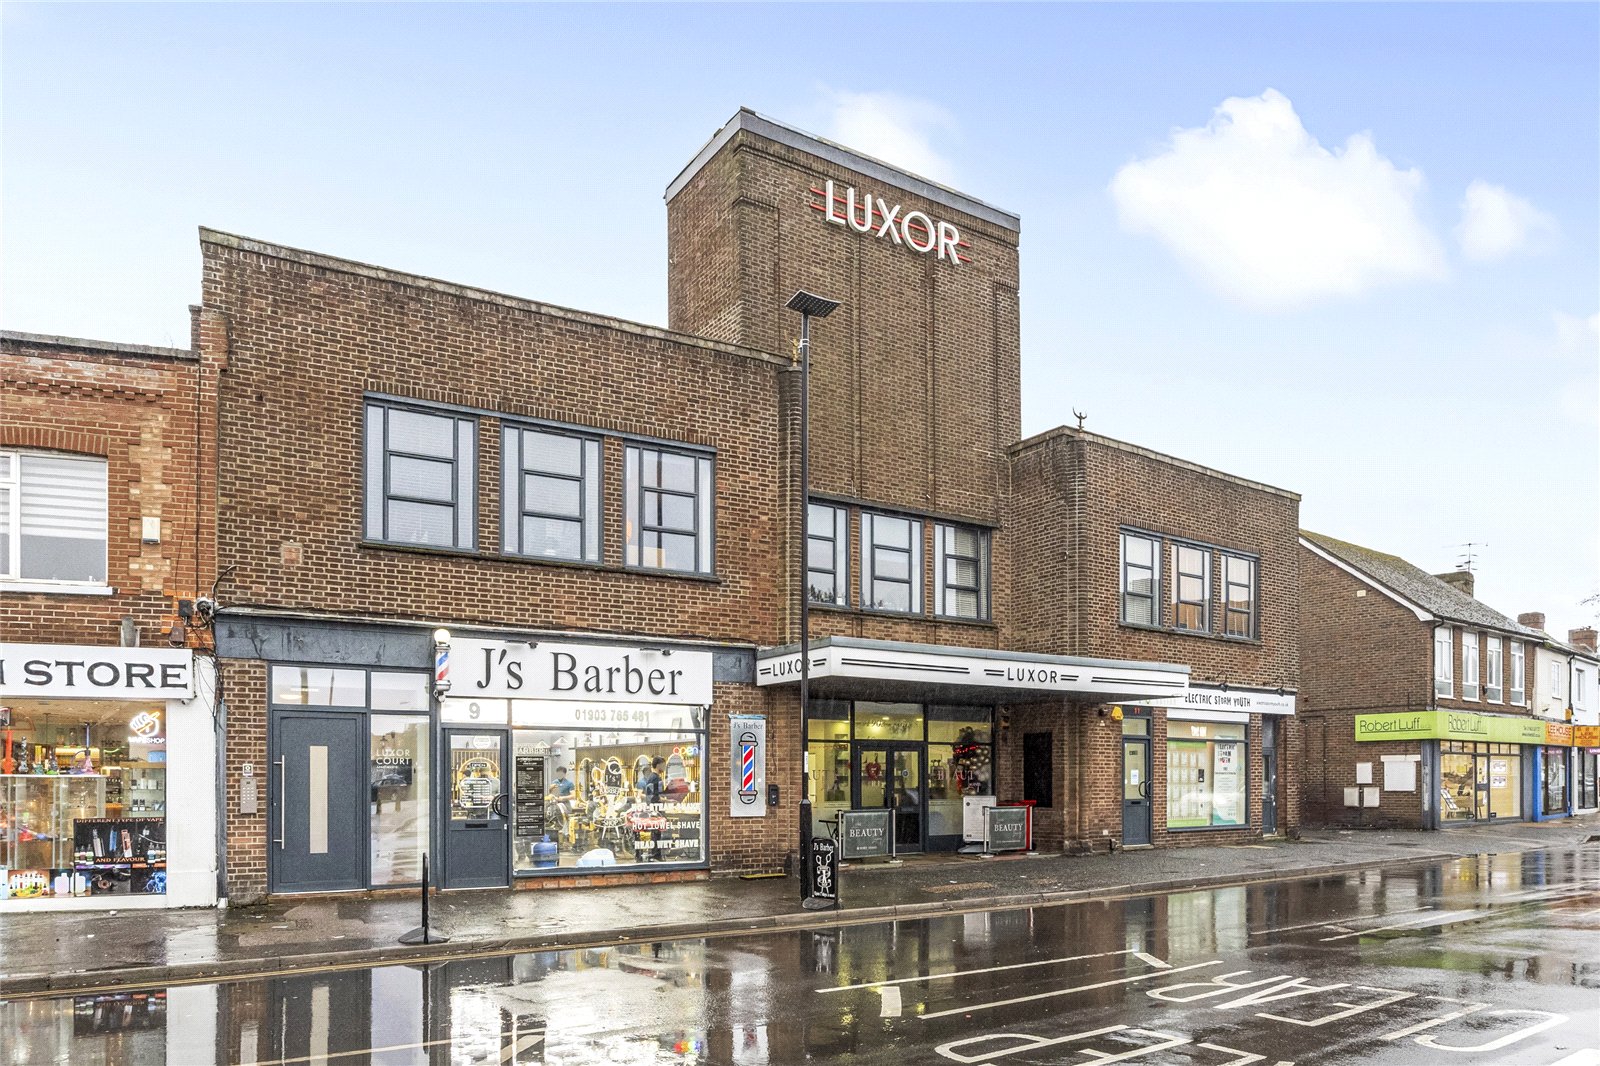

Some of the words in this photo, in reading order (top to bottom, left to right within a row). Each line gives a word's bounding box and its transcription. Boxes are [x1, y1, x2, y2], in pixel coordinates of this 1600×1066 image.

[825, 179, 960, 266] LUXOR
[23, 659, 188, 690] STORE
[476, 647, 524, 690] J's
[549, 650, 683, 696] Barber
[1007, 667, 1058, 684] LUXOR
[469, 702, 481, 720] 9
[575, 709, 607, 721] 01903
[631, 710, 650, 722] 481
[743, 722, 764, 730] Barber
[1359, 719, 1397, 732] Robert
[1398, 716, 1421, 730] Luff
[1448, 714, 1470, 731] Robert
[376, 749, 410, 757] LUXOR
[376, 757, 410, 765] COURT
[632, 822, 647, 830] HOT
[650, 821, 674, 830] TOWEL
[677, 821, 700, 829] SHAVE
[995, 823, 1023, 832] BEAUTY
[849, 828, 885, 838] BEAUTY
[634, 840, 655, 850] HEAD
[656, 840, 673, 849] WET
[674, 839, 699, 848] SHAVE
[820, 843, 834, 851] Barber
